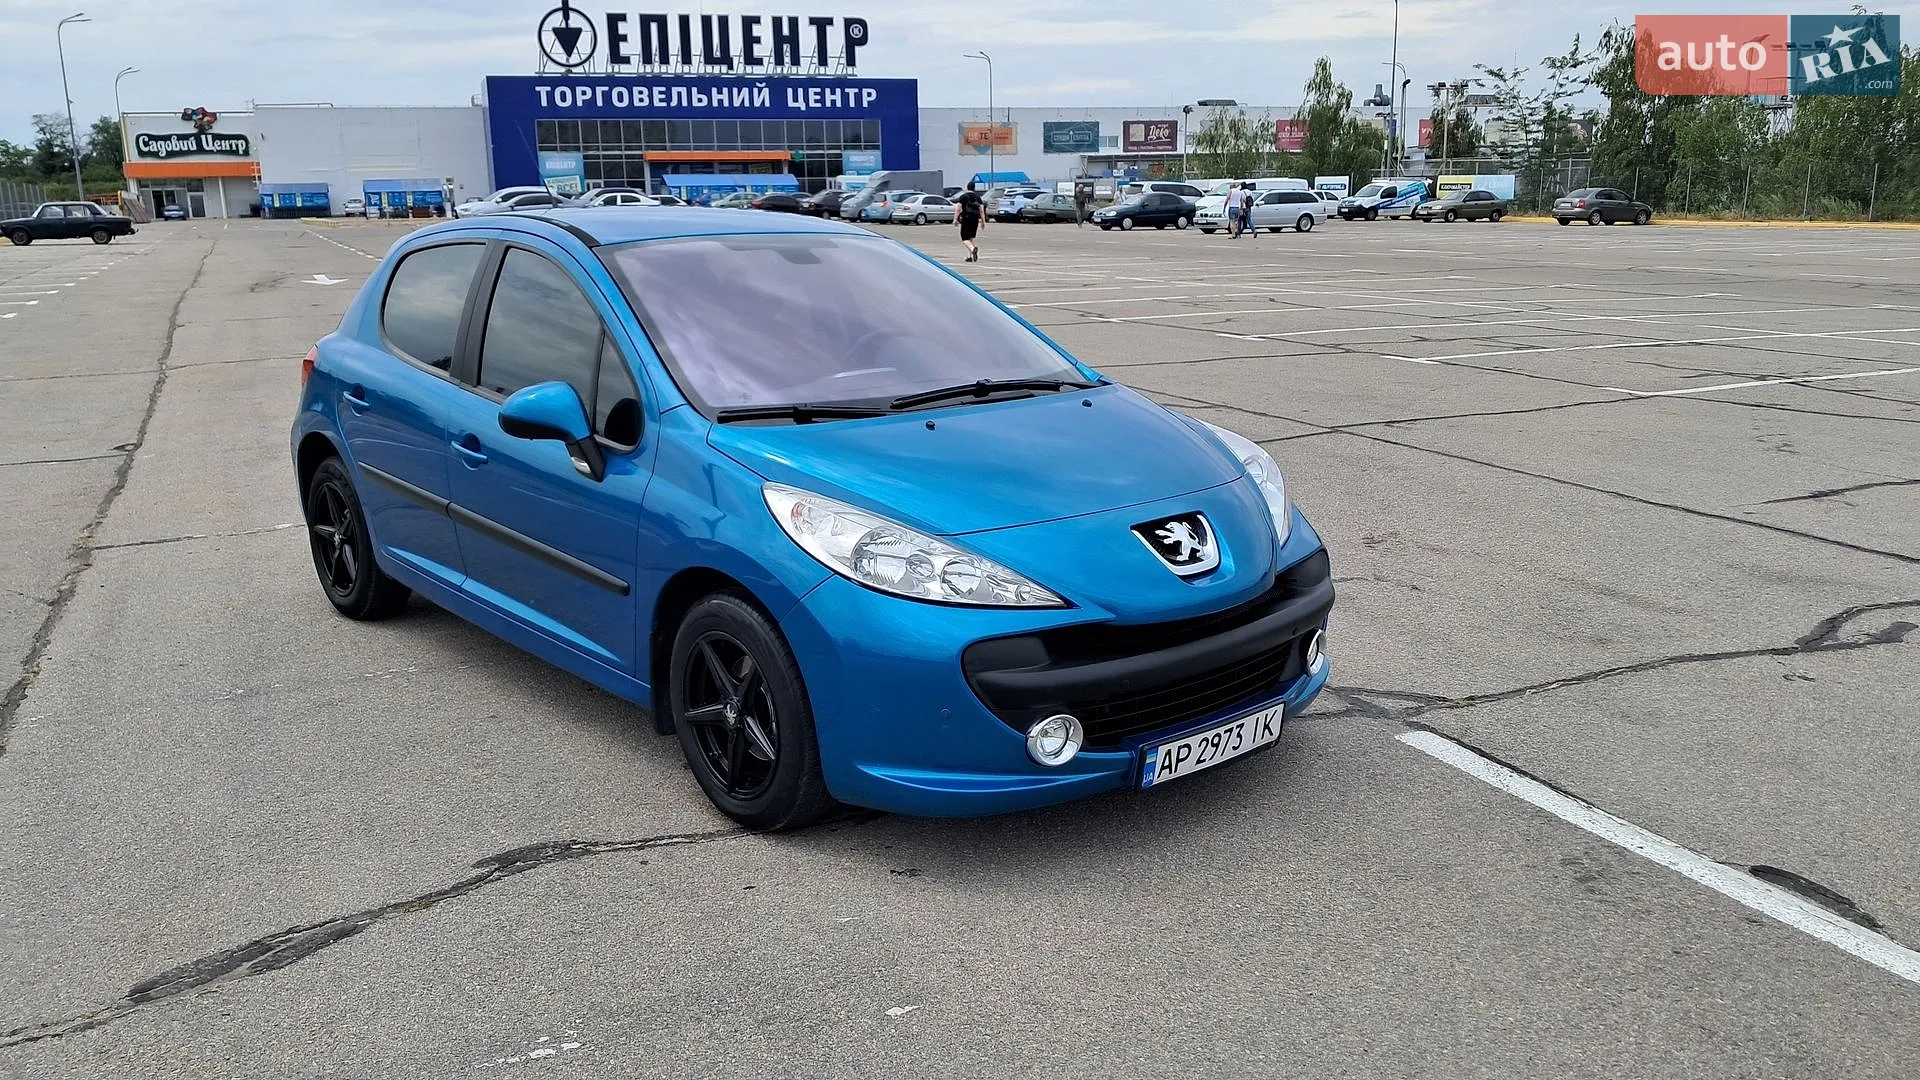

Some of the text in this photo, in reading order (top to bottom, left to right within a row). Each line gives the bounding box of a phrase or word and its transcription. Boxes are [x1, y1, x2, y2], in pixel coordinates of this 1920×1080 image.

[605, 12, 869, 70] ЕПІЦЕНТР
[535, 82, 879, 111] ТОРГОВЕЛЬНИЙ ЦЕНТР
[138, 134, 246, 157] Садовий Центр
[1157, 709, 1279, 779] AP 2973 IK
